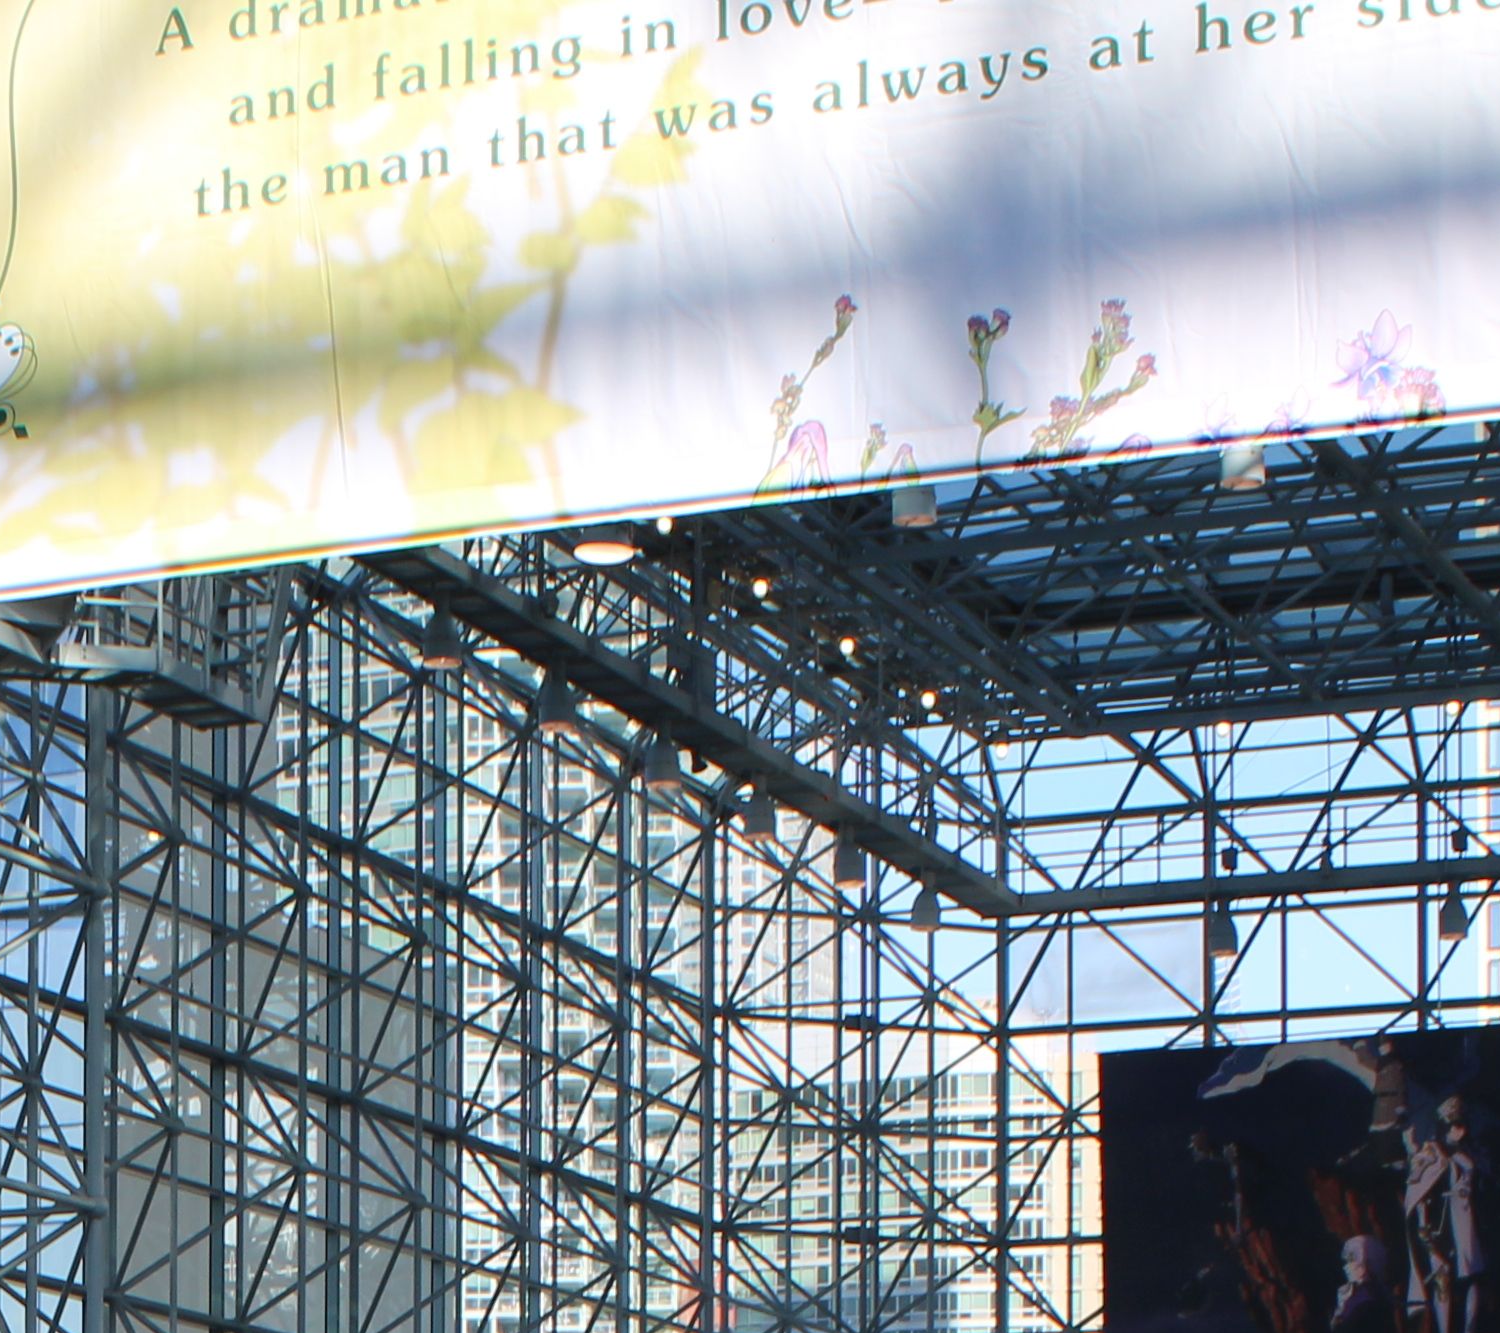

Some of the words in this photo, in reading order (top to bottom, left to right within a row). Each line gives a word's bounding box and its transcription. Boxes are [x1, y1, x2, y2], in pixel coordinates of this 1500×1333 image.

[154, 6, 195, 56] A
[228, 63, 337, 126] and
[372, 34, 585, 101] falling
[620, 13, 677, 58] in
[193, 167, 289, 218] the
[323, 145, 451, 195] man
[487, 109, 619, 169] that
[654, 91, 776, 141] was
[811, 48, 1050, 114] always
[1088, 18, 1157, 71] at
[1195, 4, 1316, 55] her
